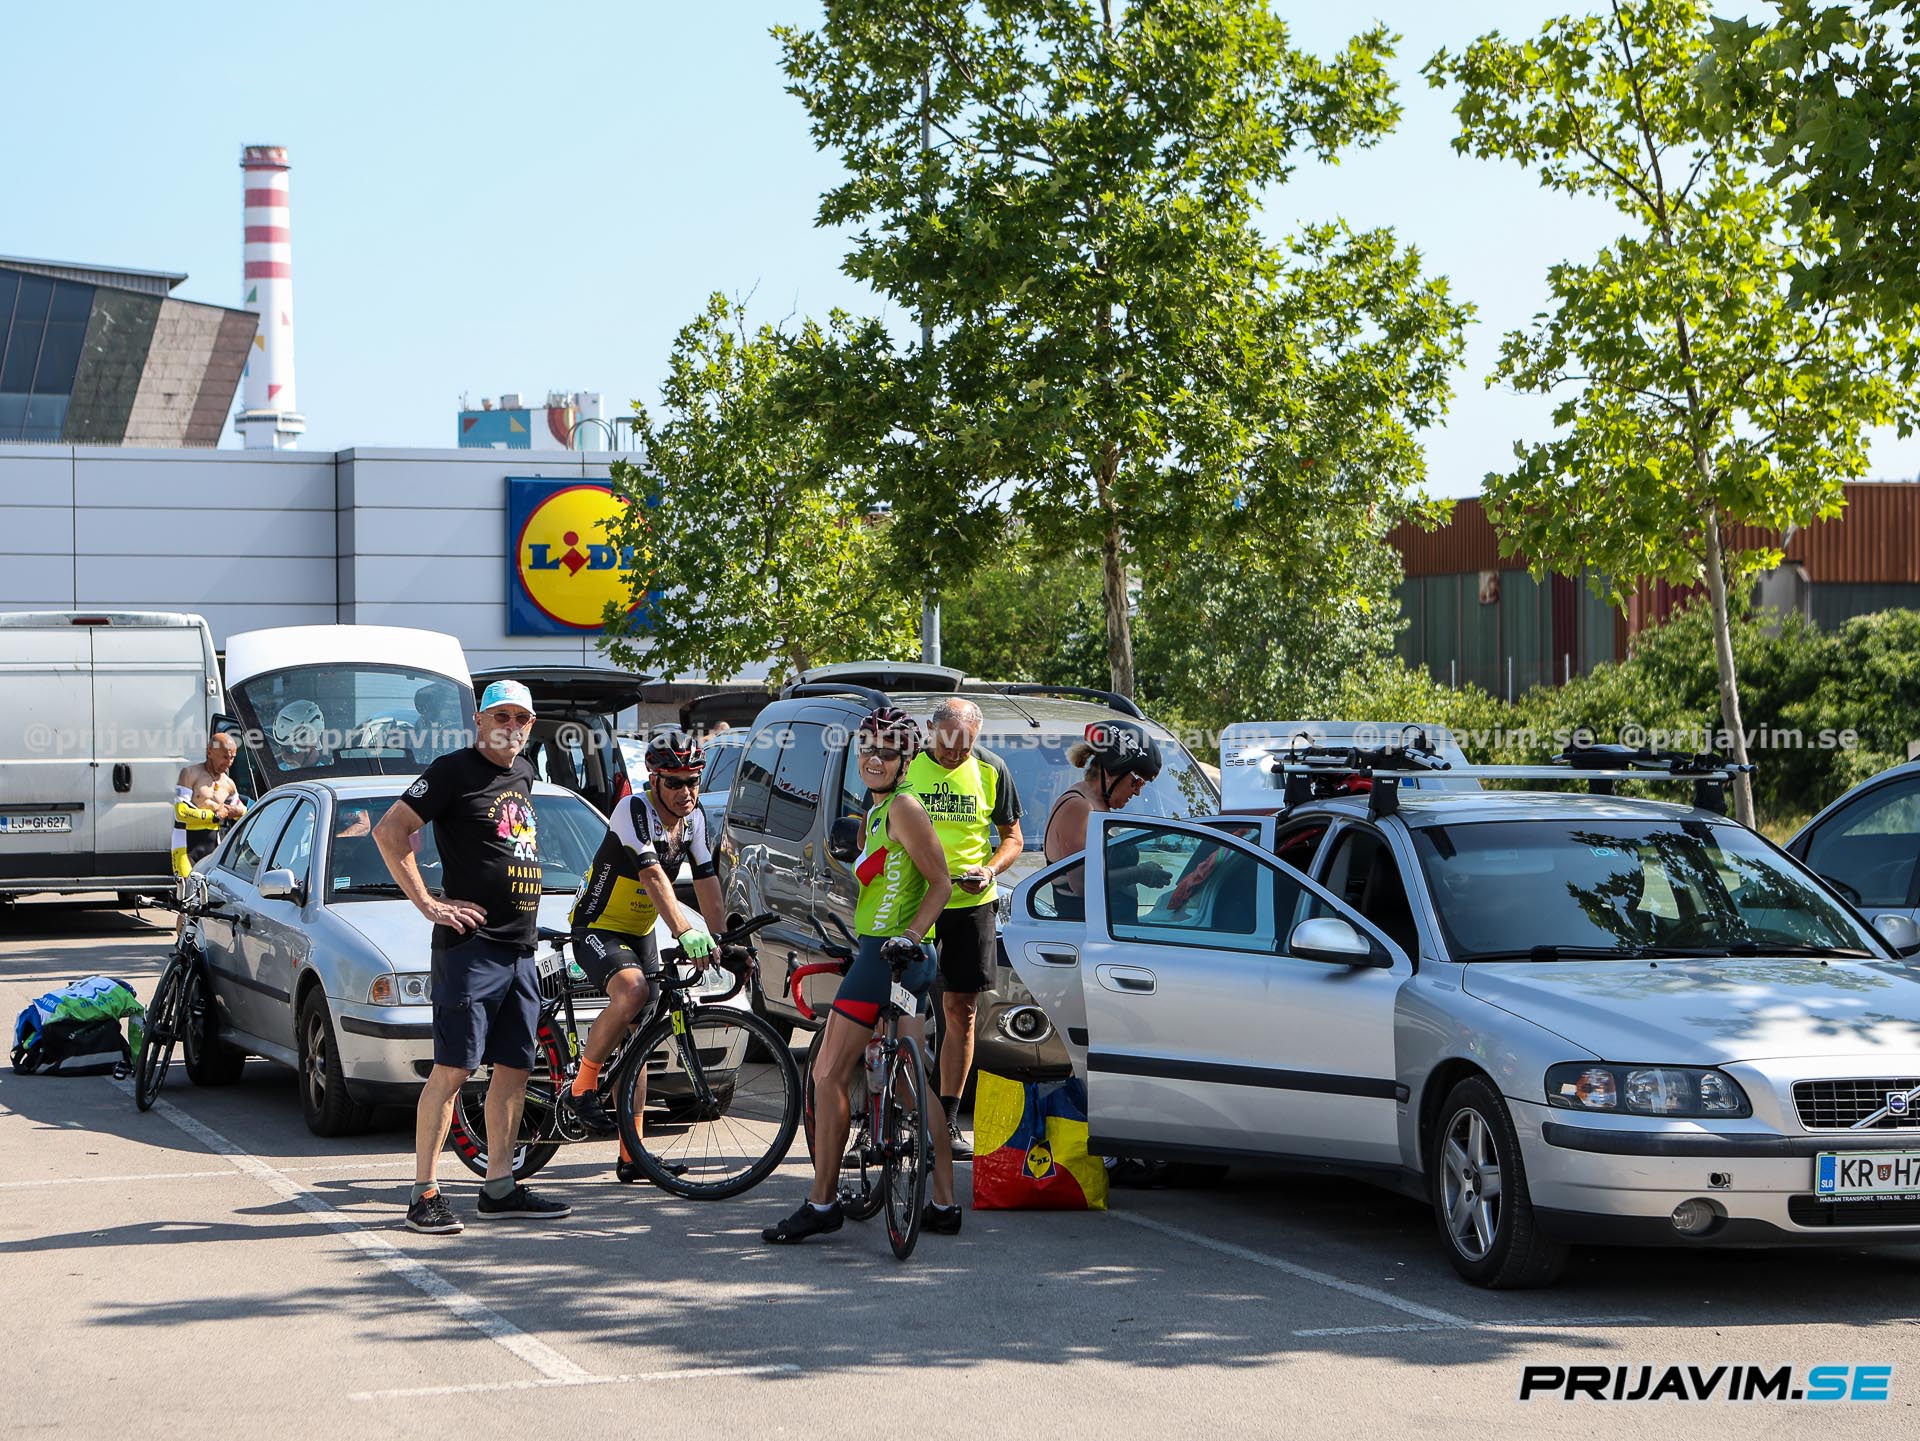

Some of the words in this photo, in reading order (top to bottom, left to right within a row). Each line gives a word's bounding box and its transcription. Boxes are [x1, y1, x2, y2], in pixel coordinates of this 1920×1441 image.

[11, 817, 25, 829] LJ
[513, 842, 538, 862] 44.
[871, 851, 903, 931] SLOVENIA
[541, 959, 553, 975] 161
[1841, 1159, 1873, 1188] KR
